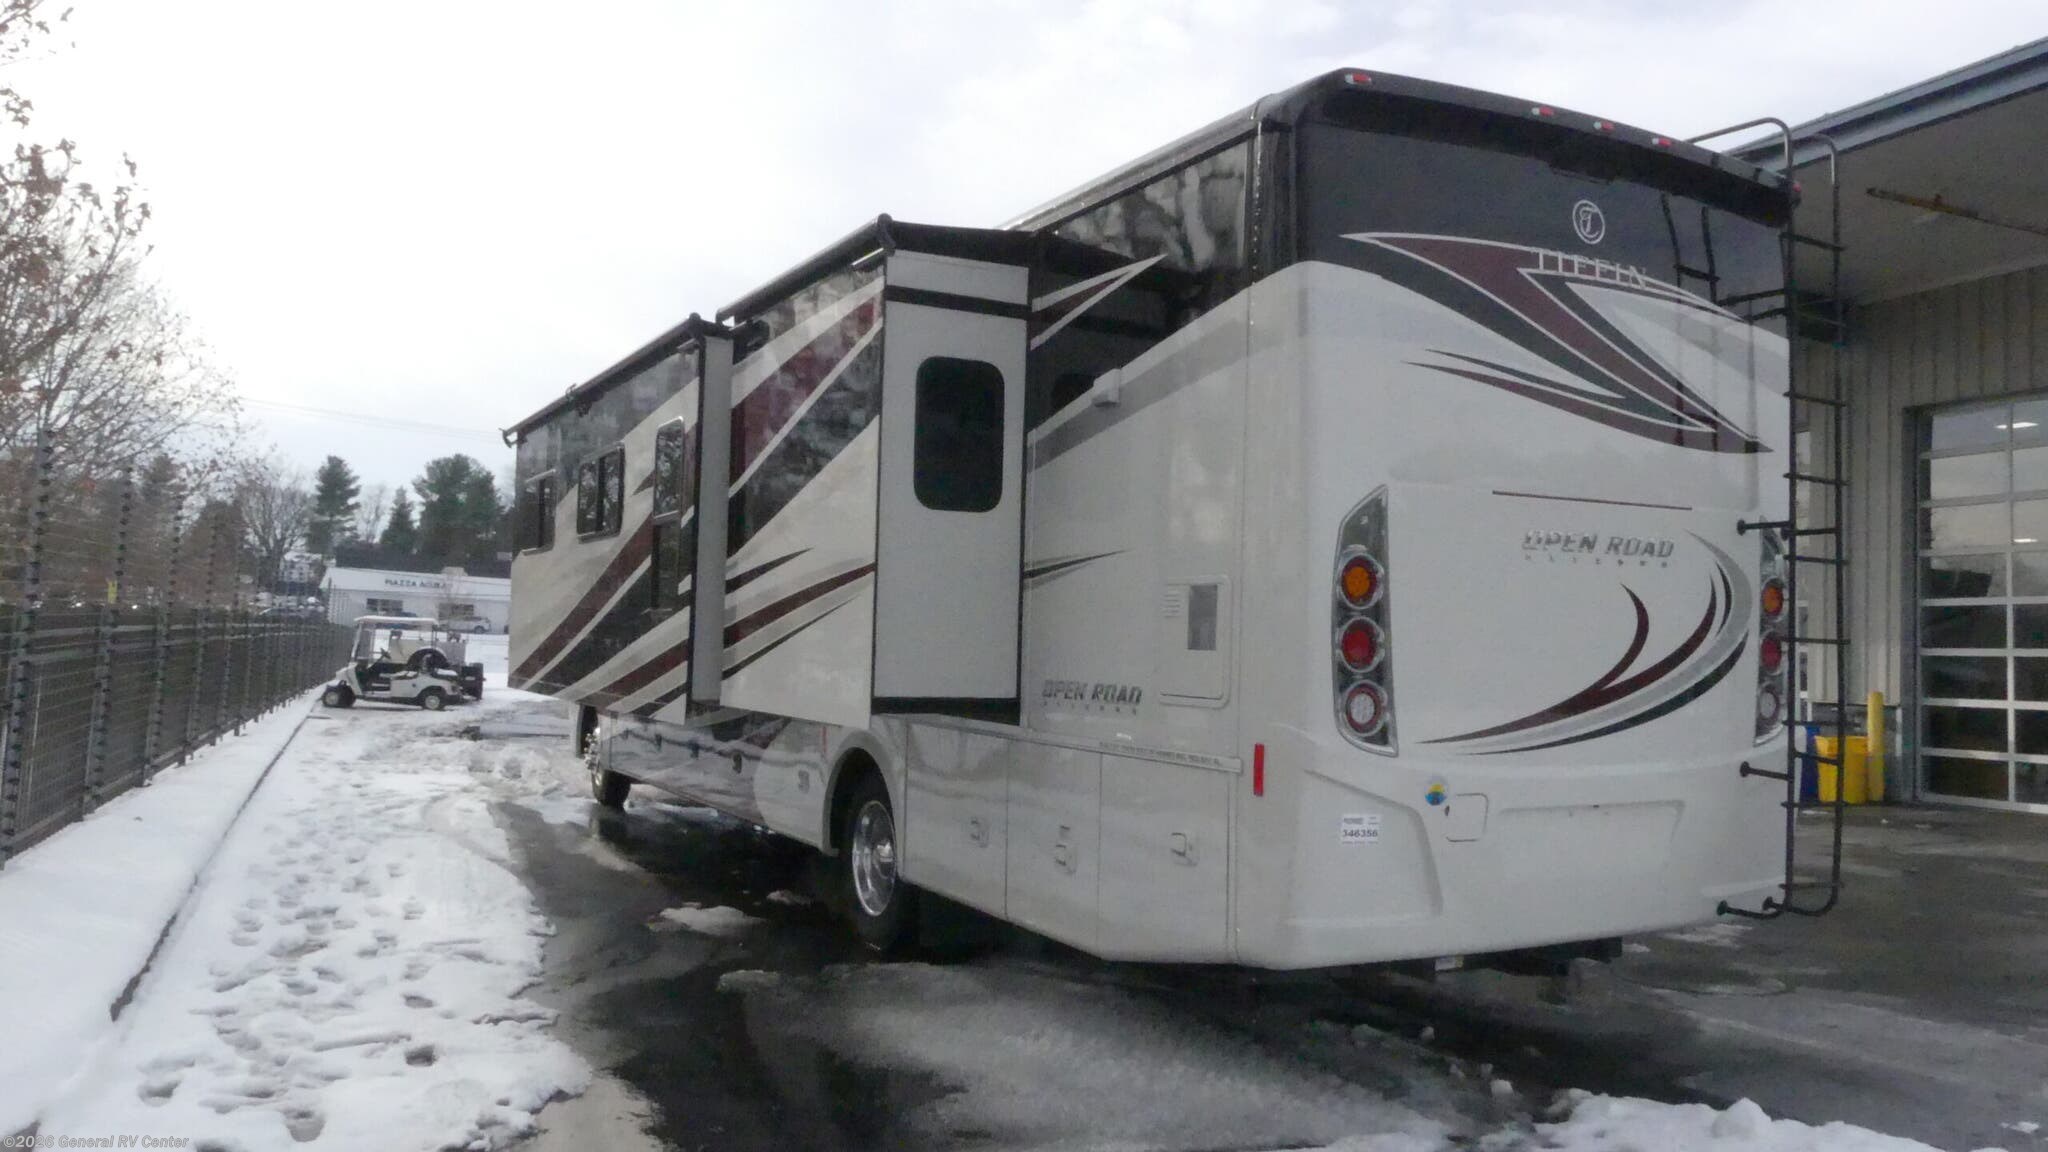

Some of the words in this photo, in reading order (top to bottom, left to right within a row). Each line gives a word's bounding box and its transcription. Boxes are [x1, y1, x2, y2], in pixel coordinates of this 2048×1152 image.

[1531, 247, 1646, 289] TIFFIN
[1522, 530, 1597, 553] OPEN
[1605, 536, 1674, 558] ROAD
[1042, 680, 1088, 700] OPEN
[1092, 684, 1143, 704] ROAD
